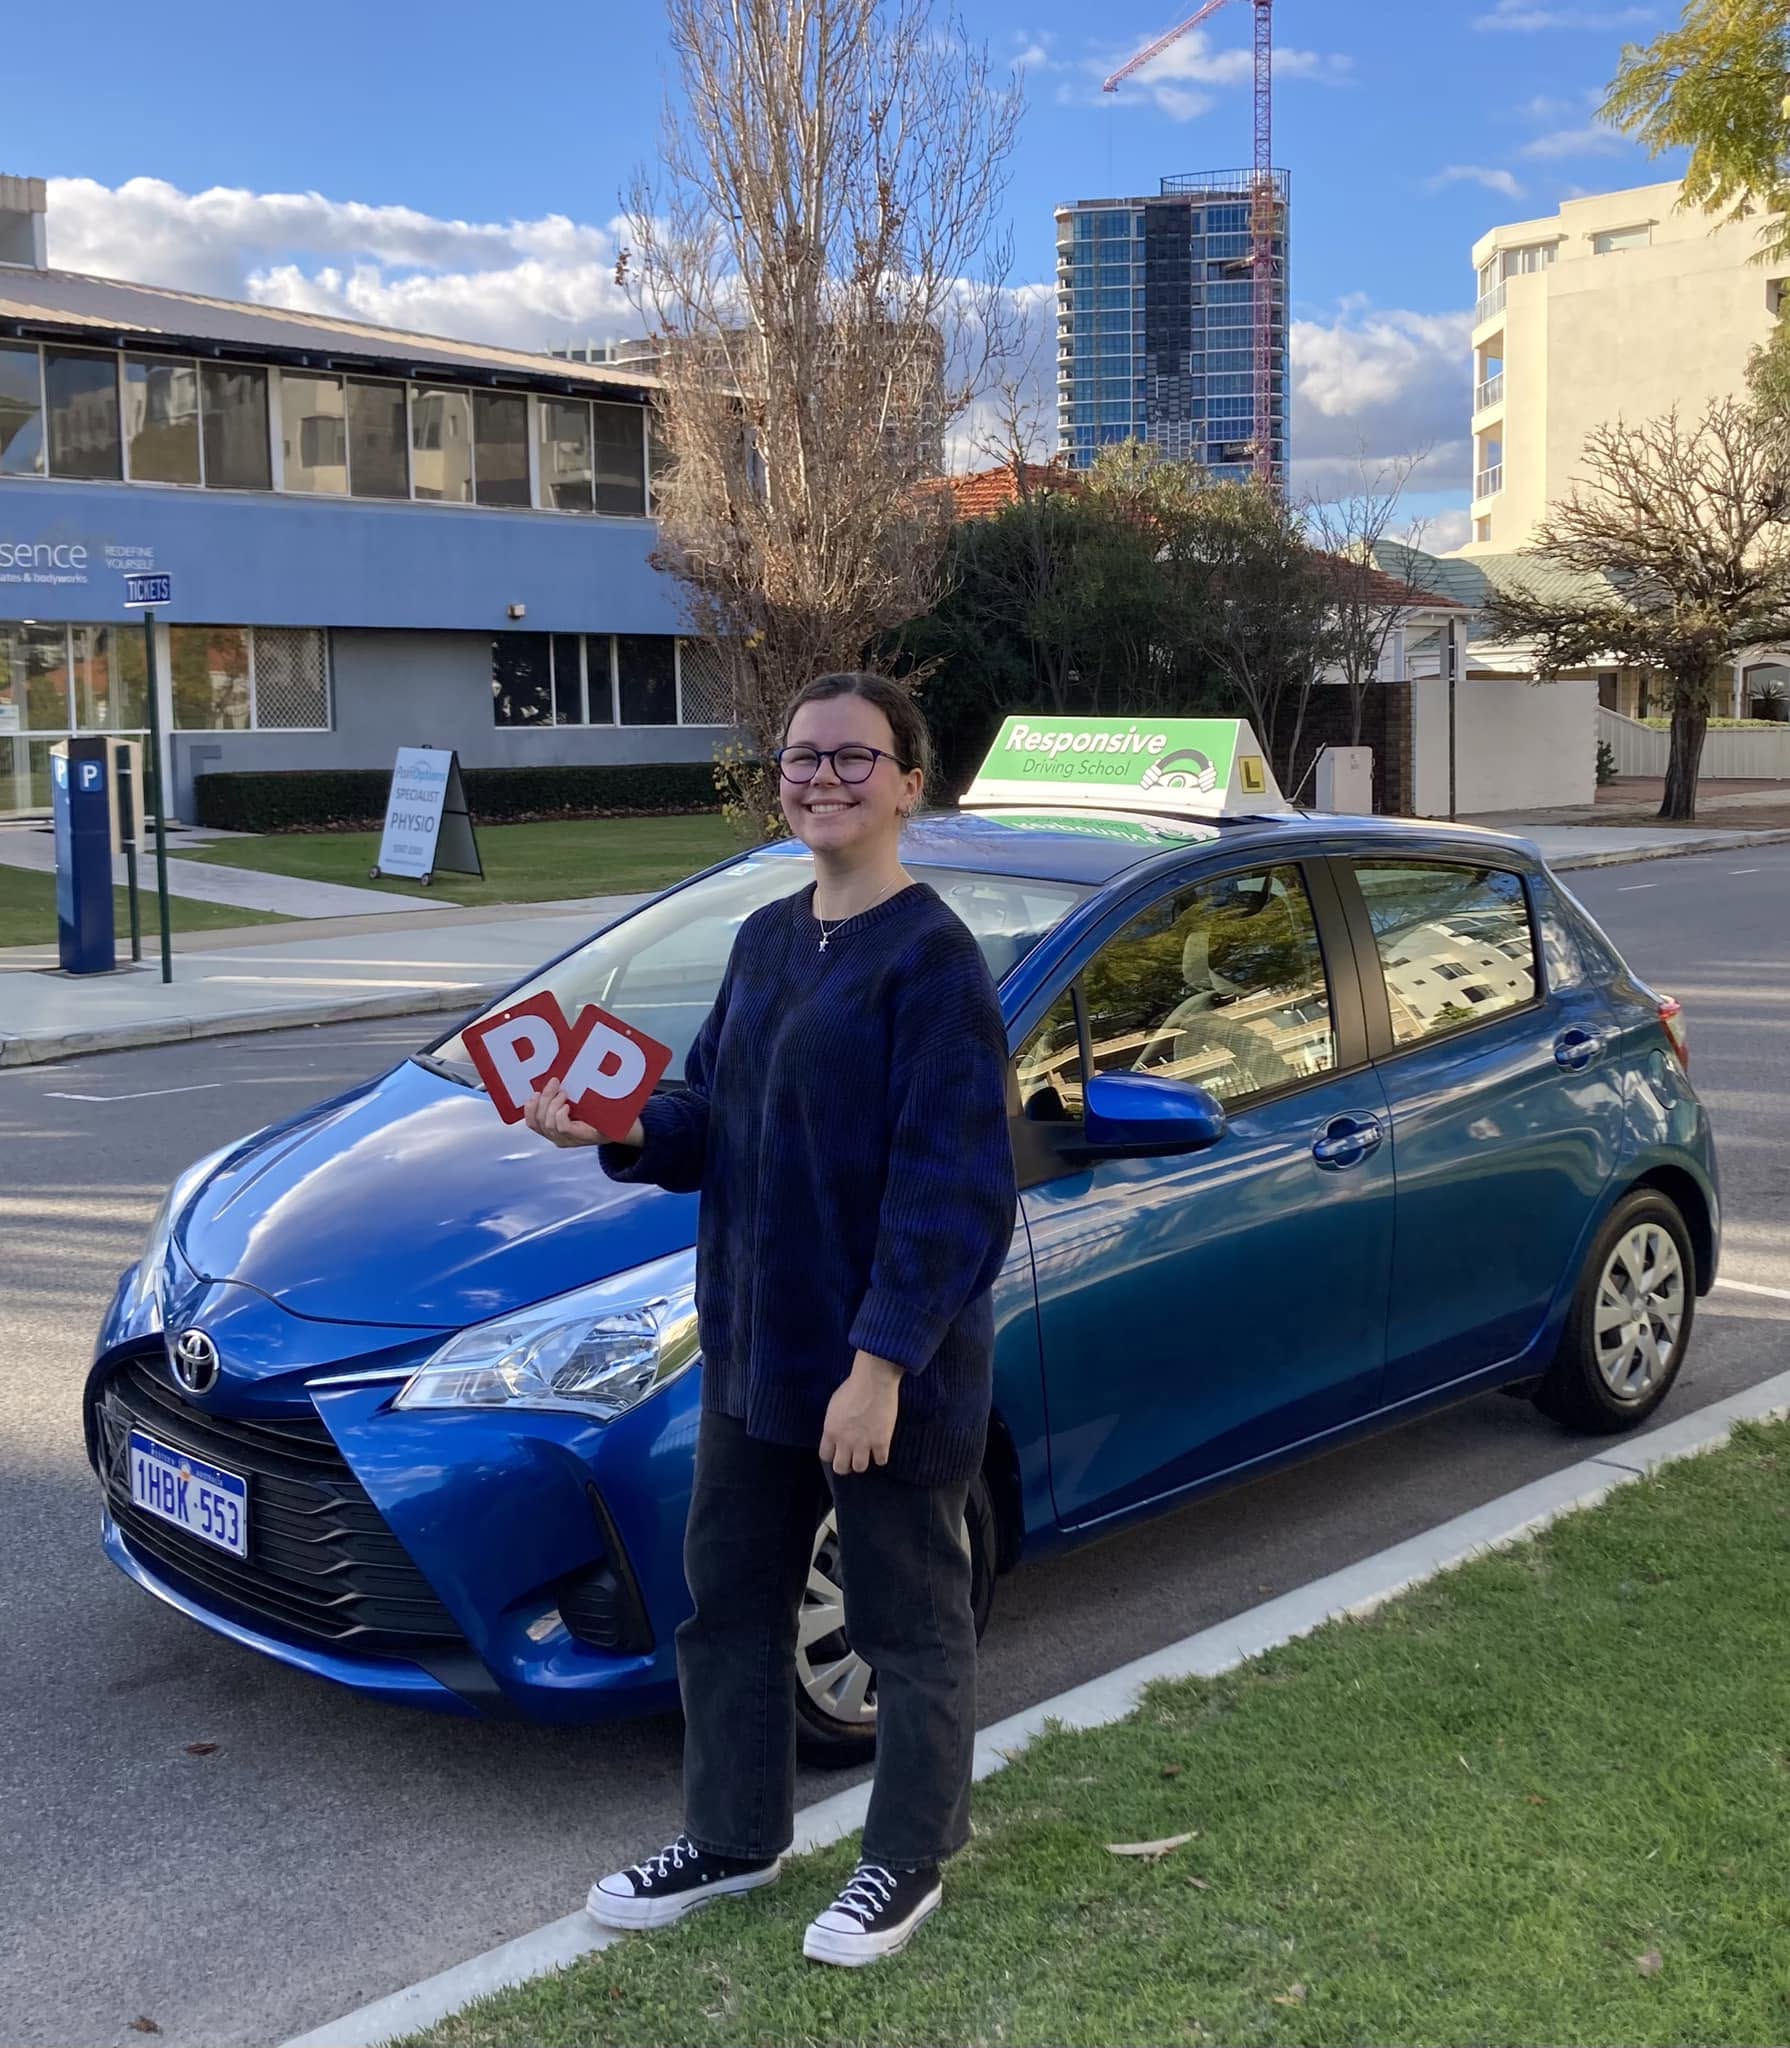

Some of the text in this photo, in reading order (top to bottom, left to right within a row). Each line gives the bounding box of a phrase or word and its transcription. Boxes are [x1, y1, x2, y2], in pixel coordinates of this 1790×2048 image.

[106, 558, 154, 570] YOURSELF
[127, 578, 169, 601] TICKETS
[1005, 724, 1168, 758] Responsive
[82, 764, 98, 788] P
[1022, 758, 1131, 778] Driving School
[1244, 760, 1260, 788] L
[395, 787, 441, 803] SPECIALIST
[390, 811, 435, 833] PHYSIO
[480, 1014, 560, 1109] P
[559, 1021, 647, 1105] P
